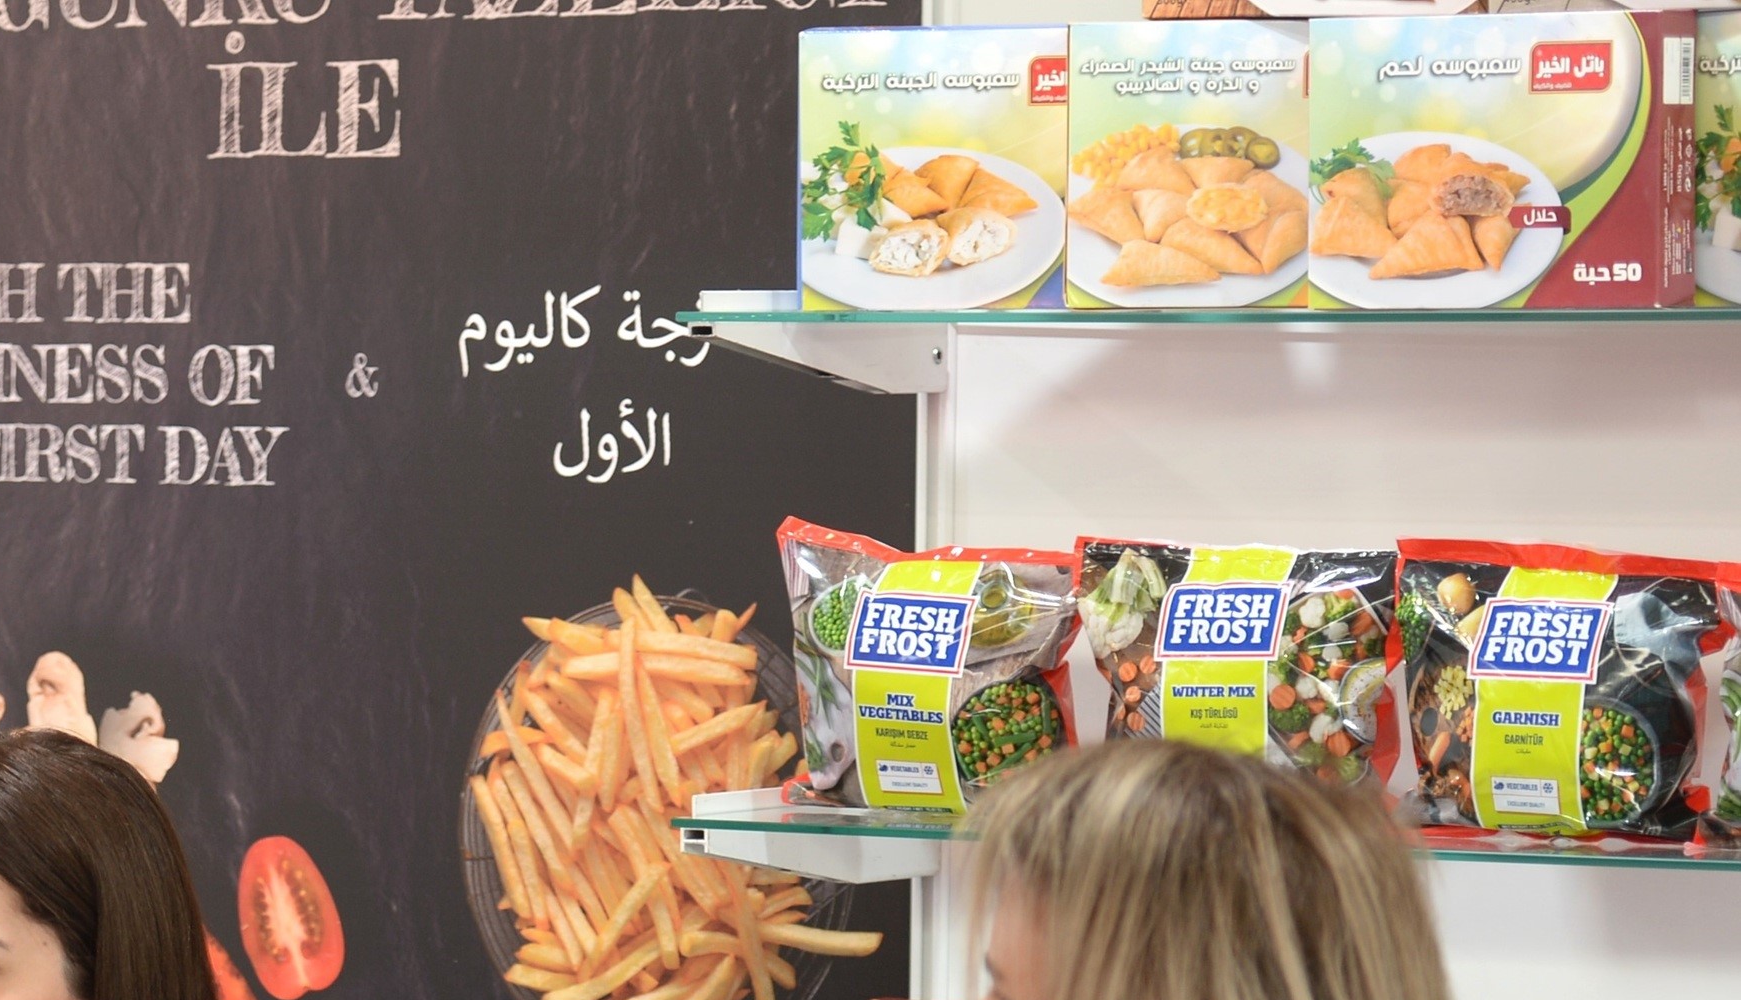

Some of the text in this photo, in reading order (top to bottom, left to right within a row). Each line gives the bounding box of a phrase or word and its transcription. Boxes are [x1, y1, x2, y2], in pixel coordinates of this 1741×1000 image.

[206, 30, 401, 159] İLE
[1523, 209, 1557, 226] حلال
[58, 261, 191, 324] THE
[459, 285, 601, 378] كاليوم
[188, 344, 275, 406] OF
[345, 352, 378, 399] &
[157, 425, 289, 486] DAY
[553, 398, 671, 484] الأول
[863, 602, 960, 633] FRESH
[1174, 594, 1275, 619] FRESH
[1170, 619, 1270, 645] FROST
[1490, 612, 1594, 640] FRESH
[859, 627, 954, 659] FROST
[1484, 637, 1588, 666] FROST
[887, 694, 914, 708] MIX
[1172, 686, 1255, 698] WINTER MIX
[858, 705, 944, 724] VEGETABLES
[1492, 711, 1560, 727] GARNISH
